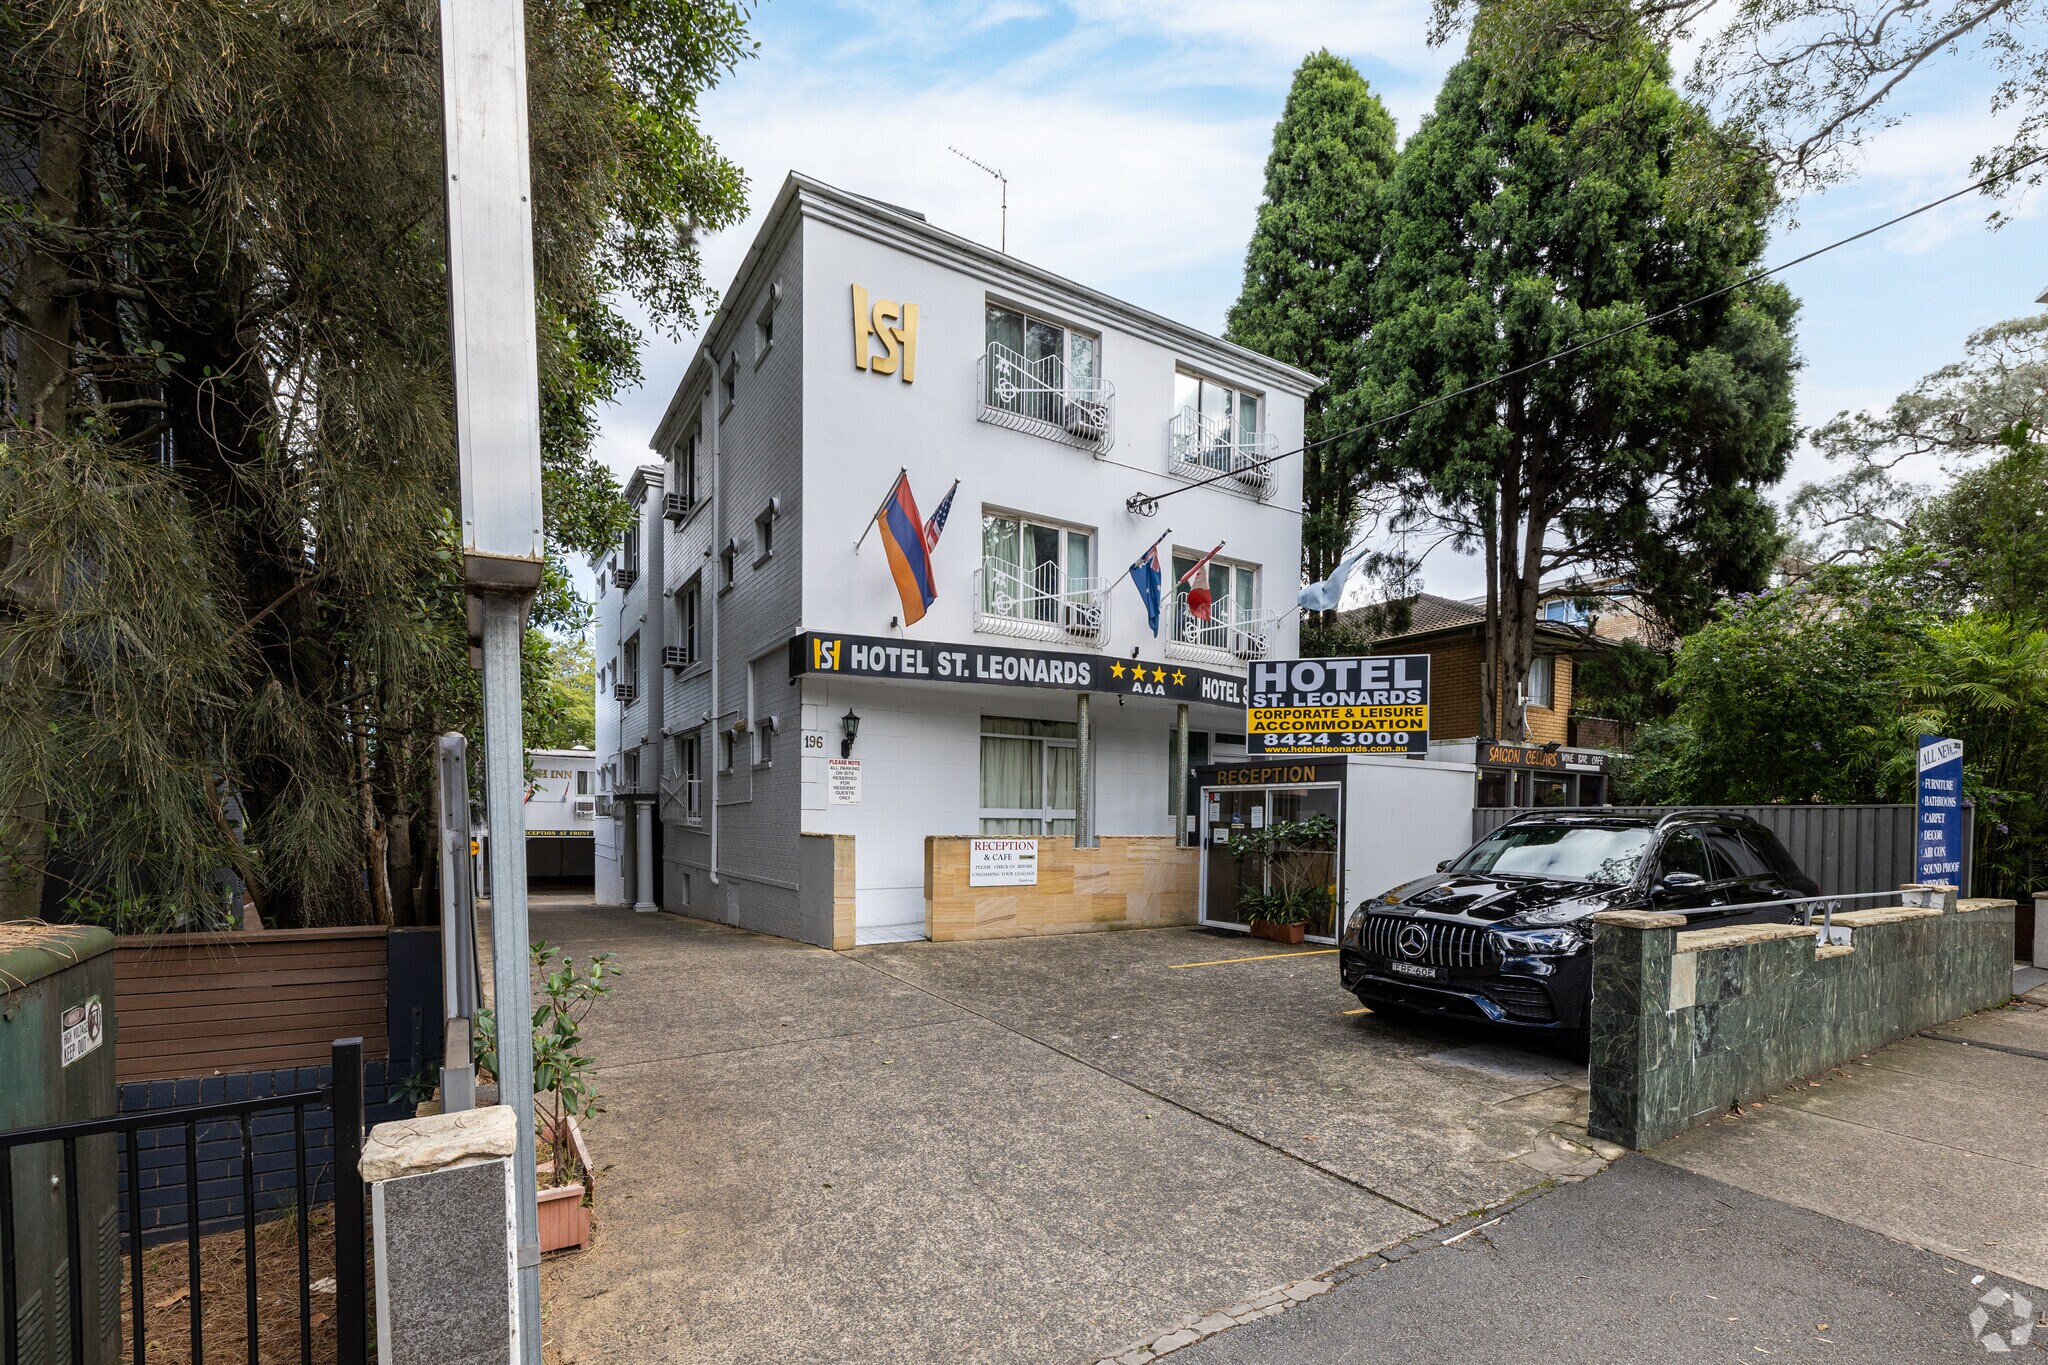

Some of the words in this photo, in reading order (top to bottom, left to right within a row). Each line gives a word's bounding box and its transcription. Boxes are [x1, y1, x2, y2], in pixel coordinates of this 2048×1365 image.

[851, 644, 929, 674] HOTEL
[937, 652, 969, 678] ST.
[976, 654, 1091, 686] LEONARDS
[1255, 658, 1422, 692] HOTEL
[1132, 682, 1166, 696] AAA
[1202, 676, 1240, 704] HOTEL
[1253, 692, 1285, 708] ST.
[1293, 690, 1422, 706] LEONARDS
[1254, 709, 1340, 720] CORPORATE
[1344, 708, 1355, 718] &
[1360, 707, 1424, 718] LEISURE
[1254, 718, 1423, 731] ACCOMMODATION
[804, 736, 823, 748] 196
[1264, 732, 1330, 746] 8424
[1341, 732, 1409, 745] 3000
[1264, 745, 1408, 753] www.hotelstleonards.com.au
[1488, 746, 1520, 764] SAIGON
[1526, 750, 1558, 767] CELLARS
[1562, 752, 1574, 762] WINE
[1578, 754, 1588, 764] BAR
[1592, 756, 1604, 765] CAFE
[1922, 749, 1936, 766] ALL
[550, 770, 573, 779] INN
[1217, 766, 1316, 784] RECEPTION
[1924, 778, 1954, 791] FURNITURE
[1924, 796, 1956, 808] BATHROOMS
[1924, 813, 1946, 824] CARPET
[1924, 830, 1942, 840] DECOR
[974, 842, 1034, 850] RECEPTION
[1922, 864, 1942, 874] SOUND
[1942, 862, 1960, 873] PROOF
[64, 1043, 76, 1064] KEEP
[78, 1036, 87, 1055] OUT
